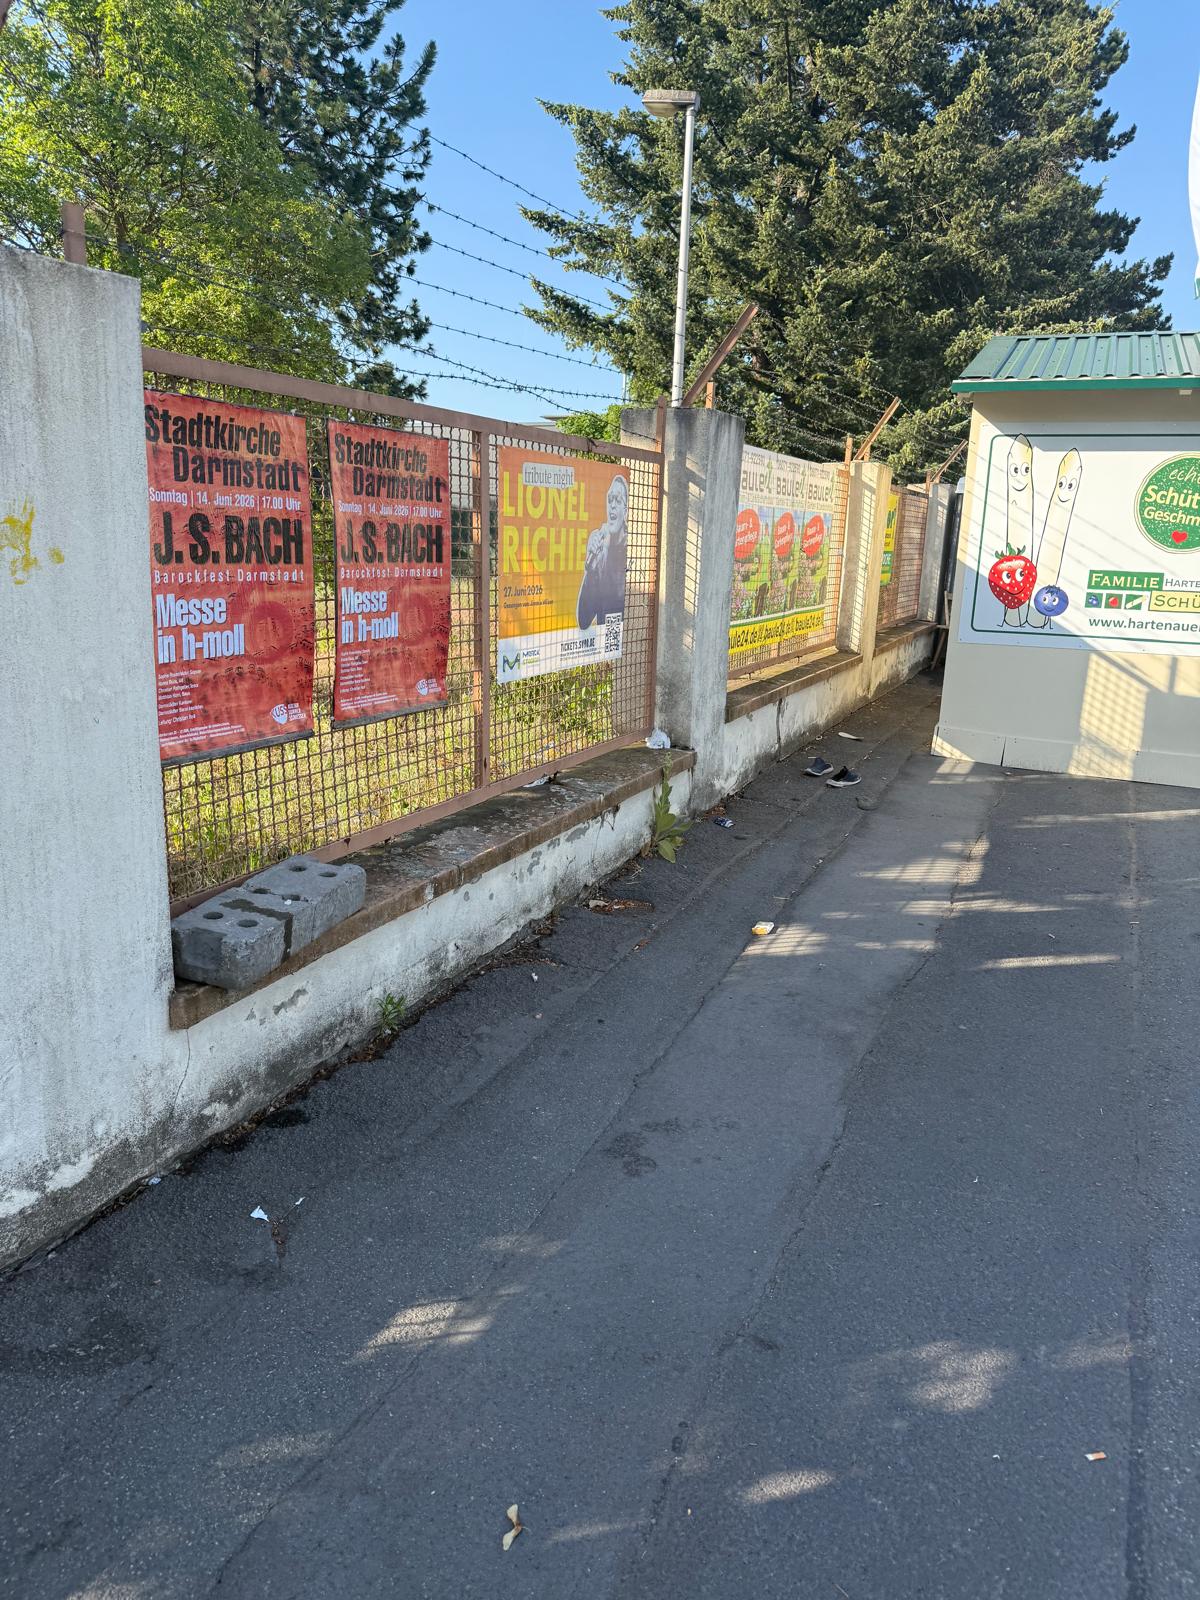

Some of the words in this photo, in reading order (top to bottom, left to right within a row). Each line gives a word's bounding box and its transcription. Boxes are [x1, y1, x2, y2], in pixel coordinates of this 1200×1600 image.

[145, 405, 281, 456] Stadtkirche
[335, 433, 427, 473] Stadtkirche
[173, 446, 301, 492] Darmstadt
[525, 467, 551, 485] tribute
[553, 467, 574, 489] night
[353, 466, 442, 502] Darmstadt
[503, 472, 589, 520] LIONEL
[1145, 485, 1200, 508] Schüt
[149, 488, 188, 505] Sonntag
[196, 491, 211, 505] 14.
[214, 491, 233, 506] Juni
[235, 493, 255, 508] 2026
[262, 496, 283, 510] 17.00
[286, 496, 301, 510] Uhr
[339, 501, 362, 515] Sonntag
[368, 503, 379, 514] 14.
[381, 504, 392, 515] Juni
[395, 505, 409, 516] 2026
[429, 507, 442, 518] Uhr
[1144, 506, 1200, 526] Geschm
[503, 525, 588, 573] RICHIE
[155, 569, 230, 584] Barockfest
[238, 568, 304, 582] Darmstadt
[340, 567, 390, 578] Barockfest
[394, 567, 443, 577] Darmstadt
[1091, 573, 1160, 588] FAMILIE
[1165, 578, 1200, 588] HARTE
[341, 587, 388, 615] Messe
[503, 586, 513, 598] 27.
[514, 585, 527, 597] Juni
[527, 584, 543, 596] 2026
[156, 593, 227, 628] Messe
[342, 615, 354, 644] in
[358, 612, 399, 642] h-moll
[158, 630, 176, 664] in
[182, 624, 245, 661] h-moll
